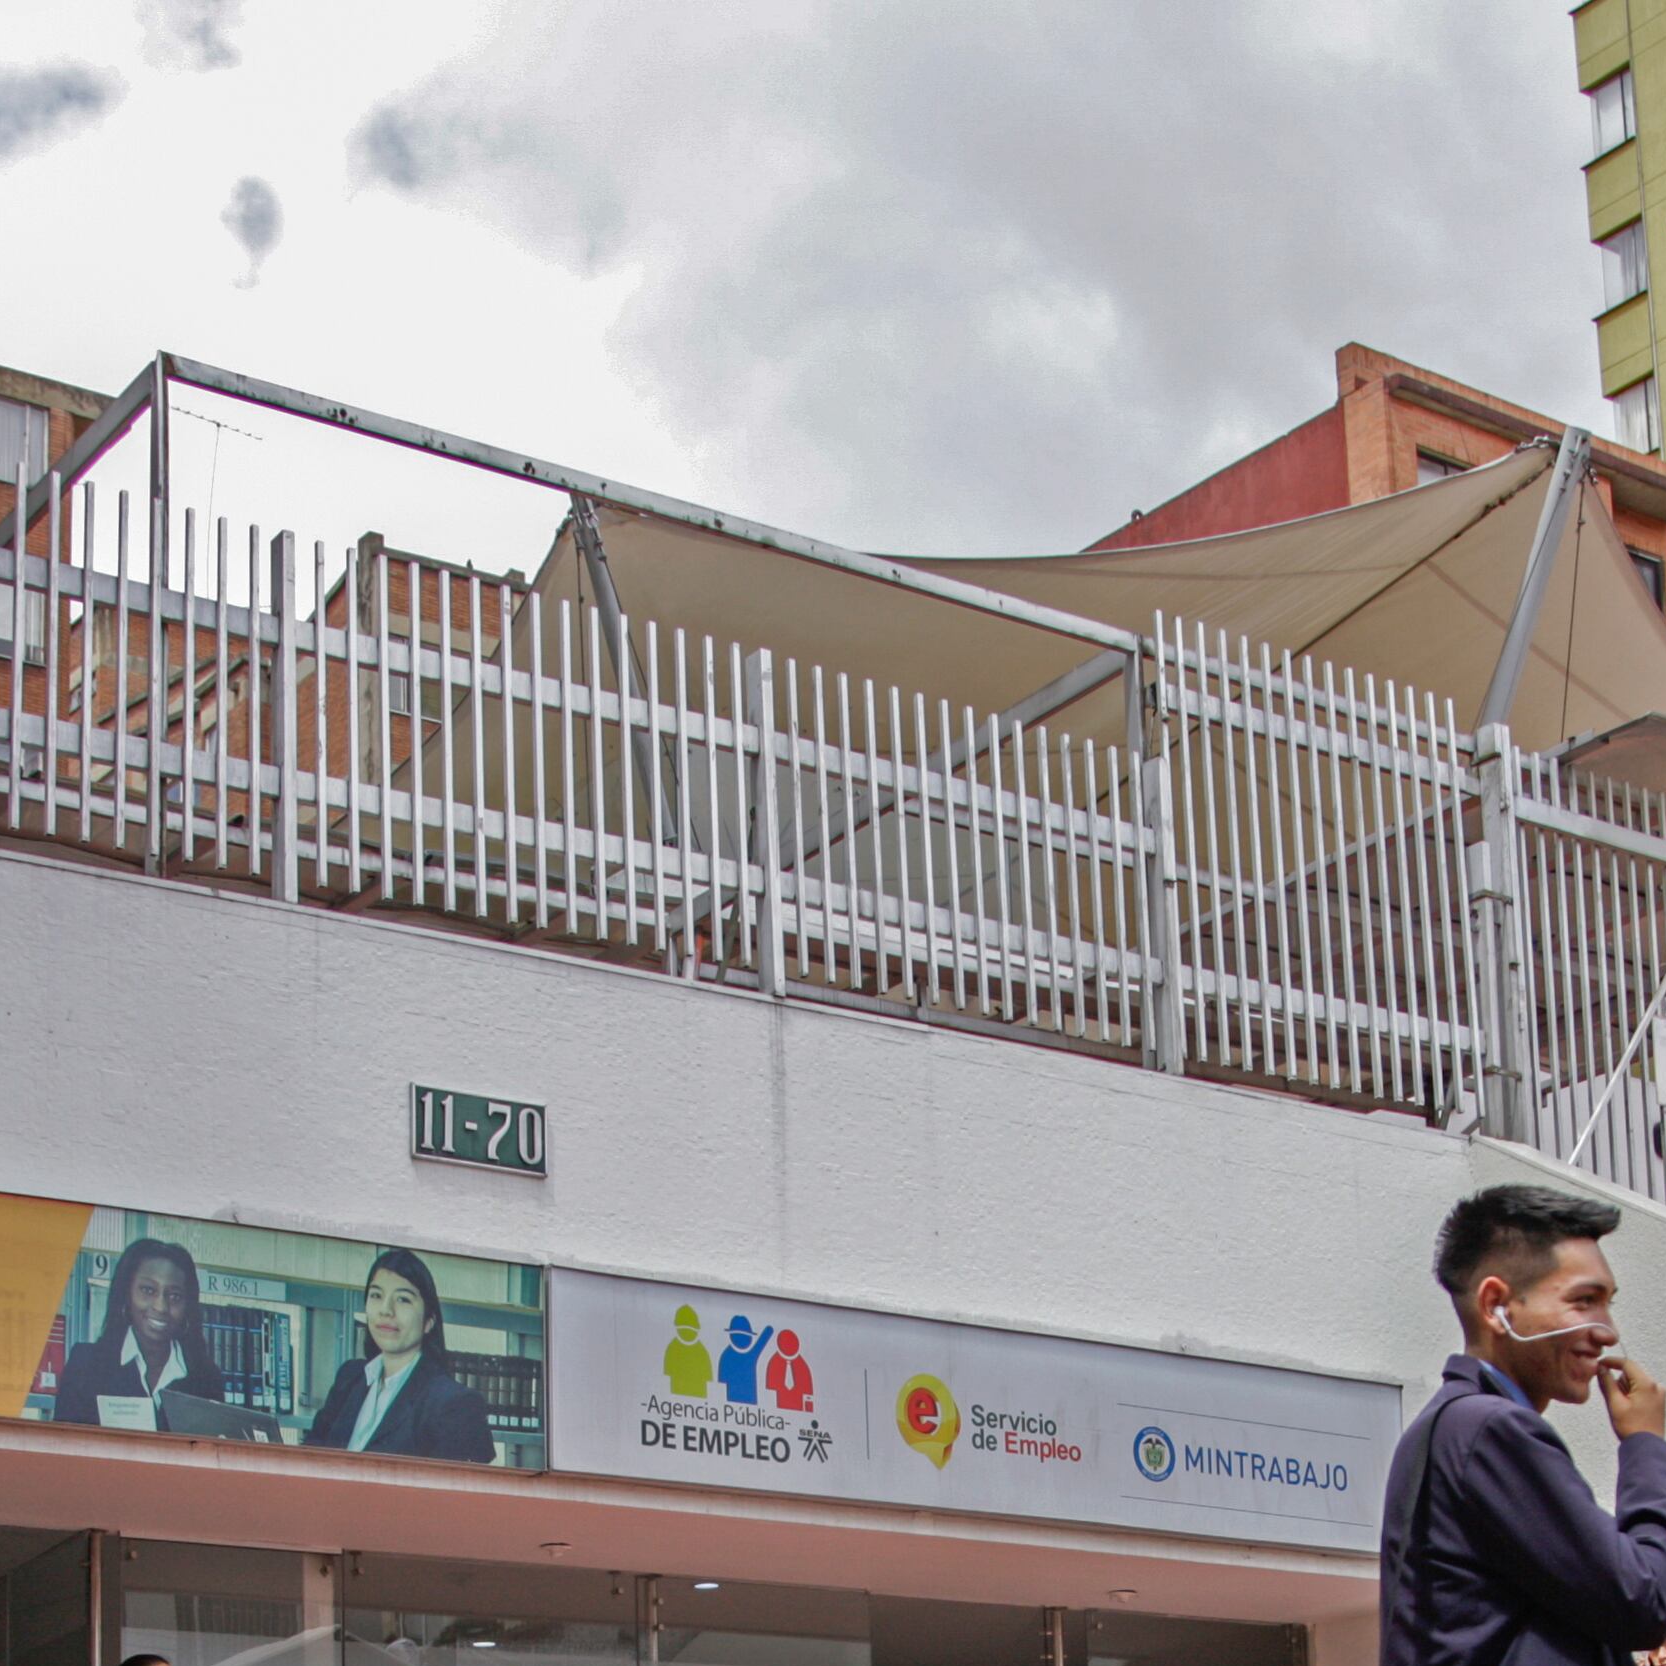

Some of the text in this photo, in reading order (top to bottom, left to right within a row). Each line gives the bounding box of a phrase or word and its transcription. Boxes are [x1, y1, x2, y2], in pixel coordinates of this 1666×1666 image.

[421, 1091, 542, 1165] 11-70
[95, 1254, 109, 1277] 9
[207, 1275, 259, 1297] R 986.1
[799, 1428, 832, 1440] SENA
[971, 1404, 1057, 1437] Servicio
[641, 1419, 791, 1464] DE EMPLEO
[971, 1429, 1083, 1463] de Empleo
[1184, 1444, 1348, 1492] MINTRABAJO
